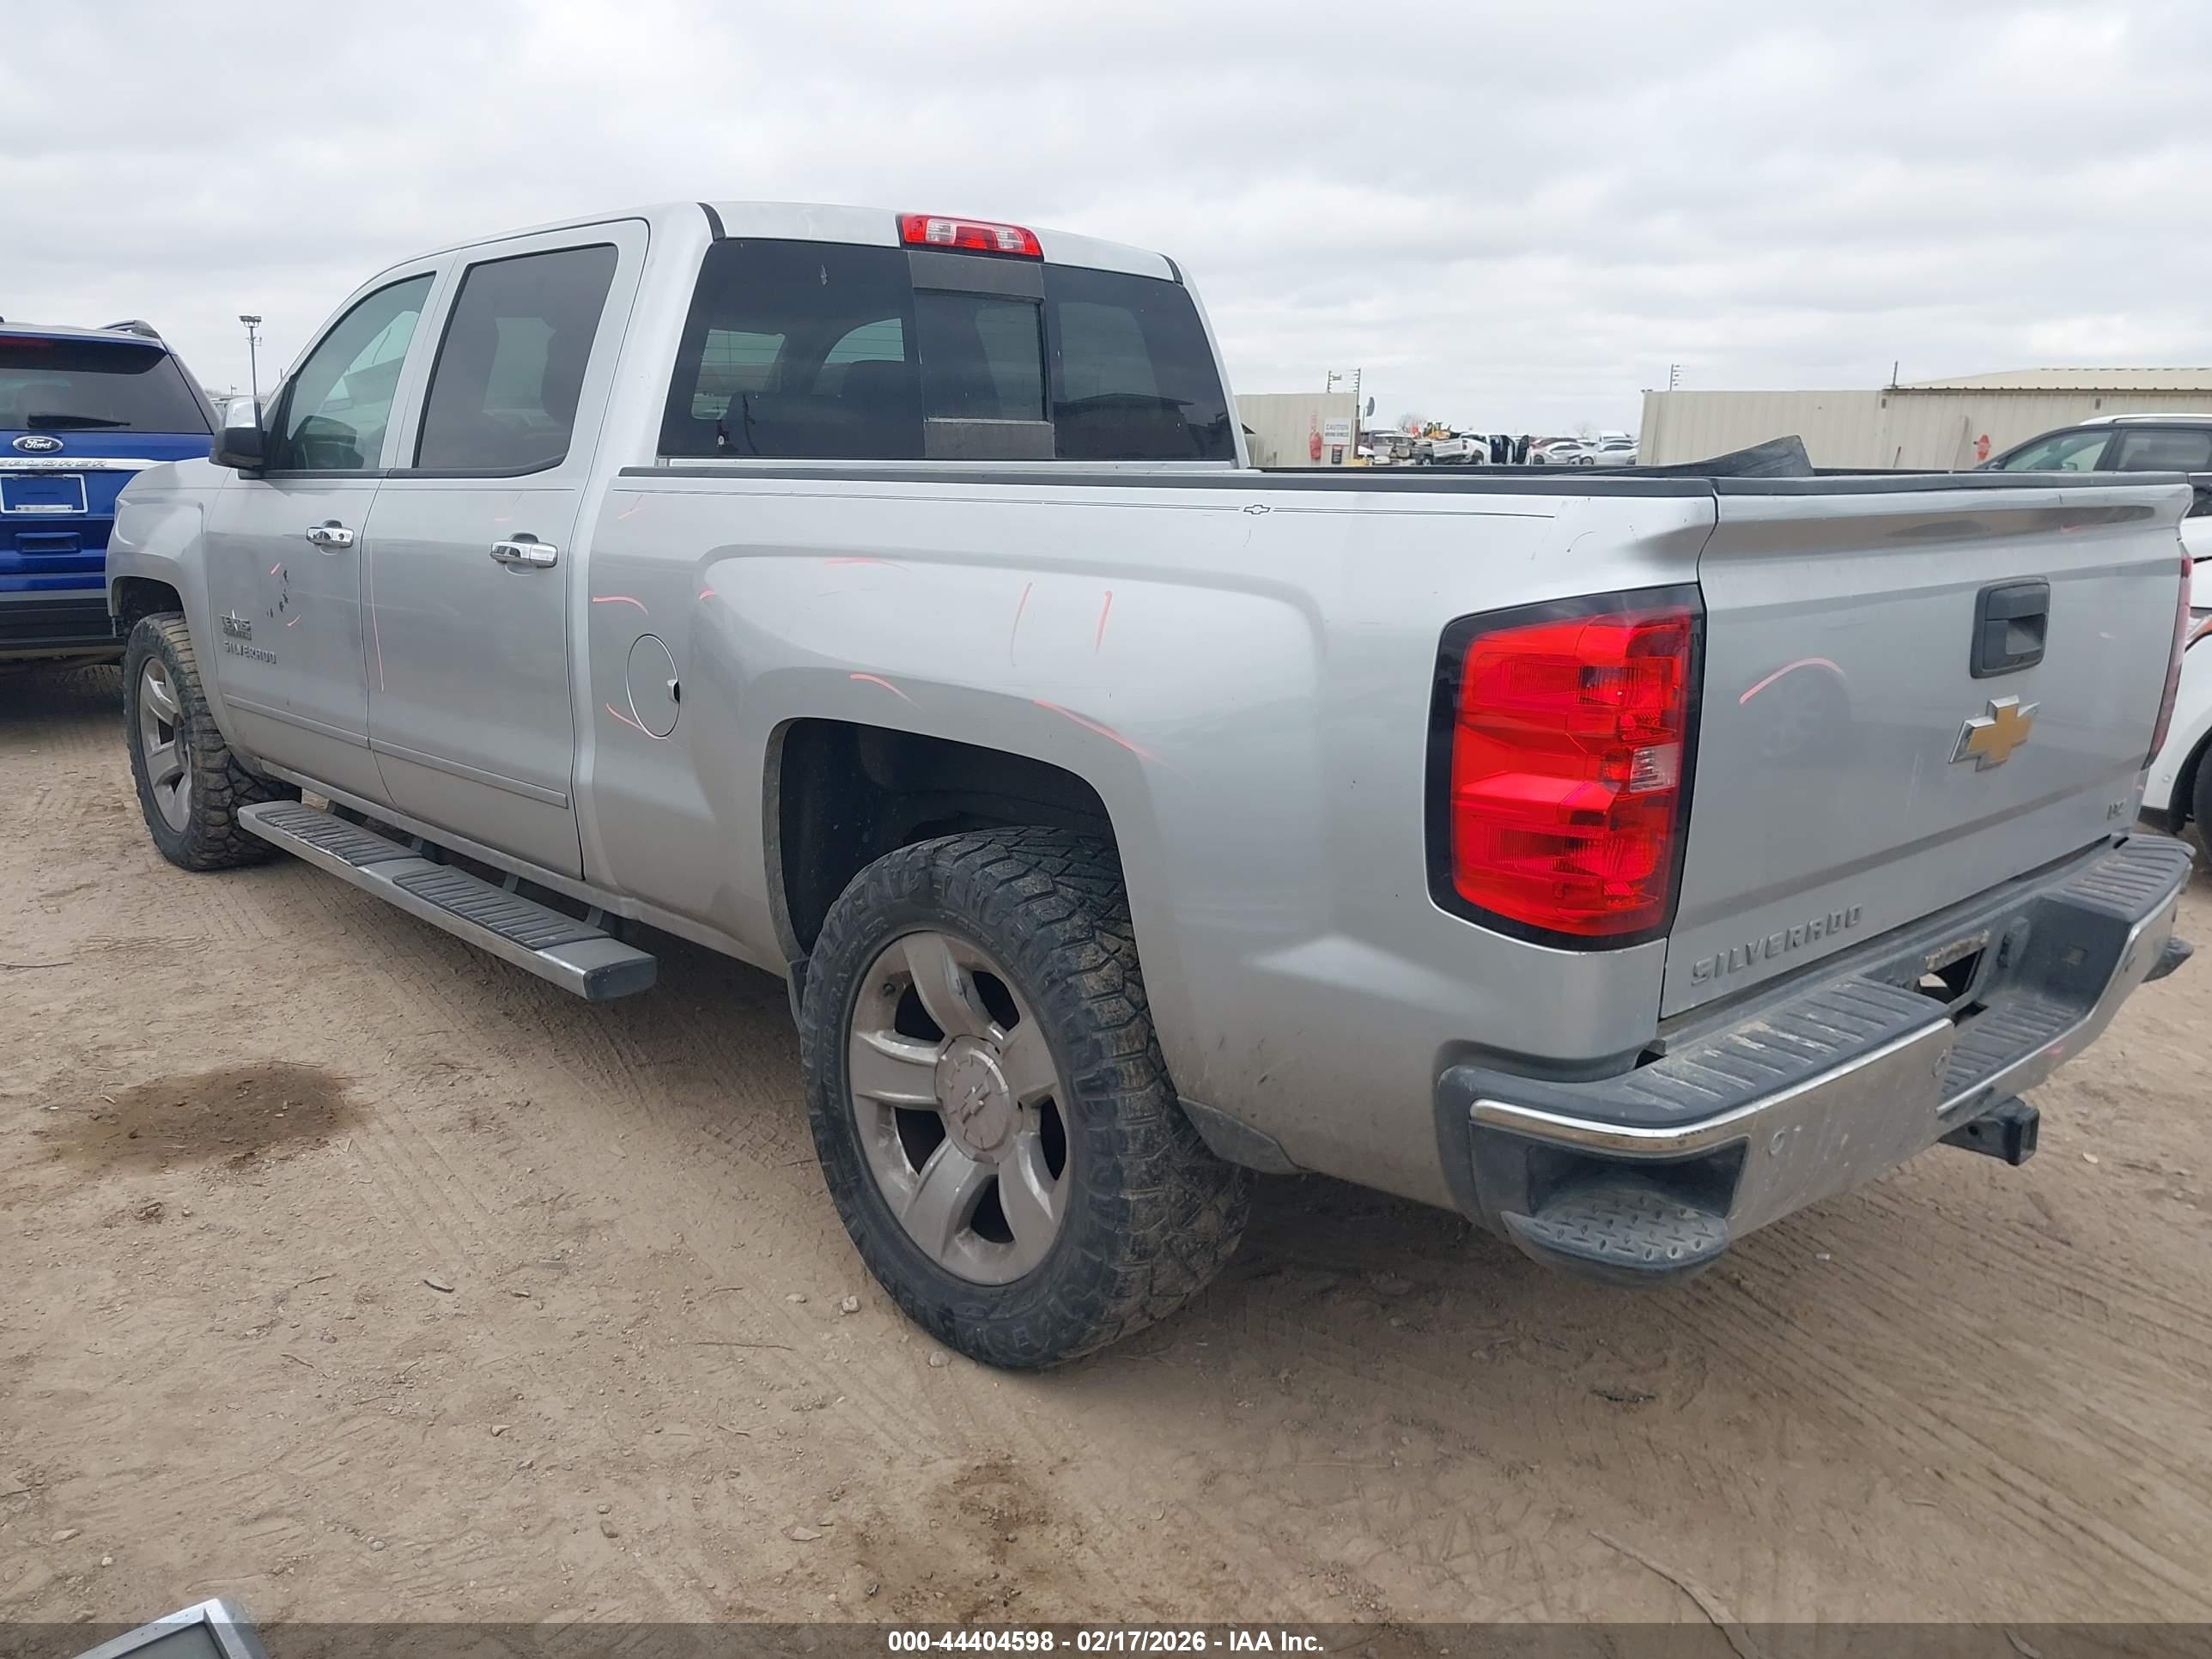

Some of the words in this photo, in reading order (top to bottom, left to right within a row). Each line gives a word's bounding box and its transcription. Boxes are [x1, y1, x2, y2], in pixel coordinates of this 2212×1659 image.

[24, 439, 52, 449] Ford
[223, 641, 276, 664] SILVERADO
[1691, 903, 1863, 987] SILVERADO
